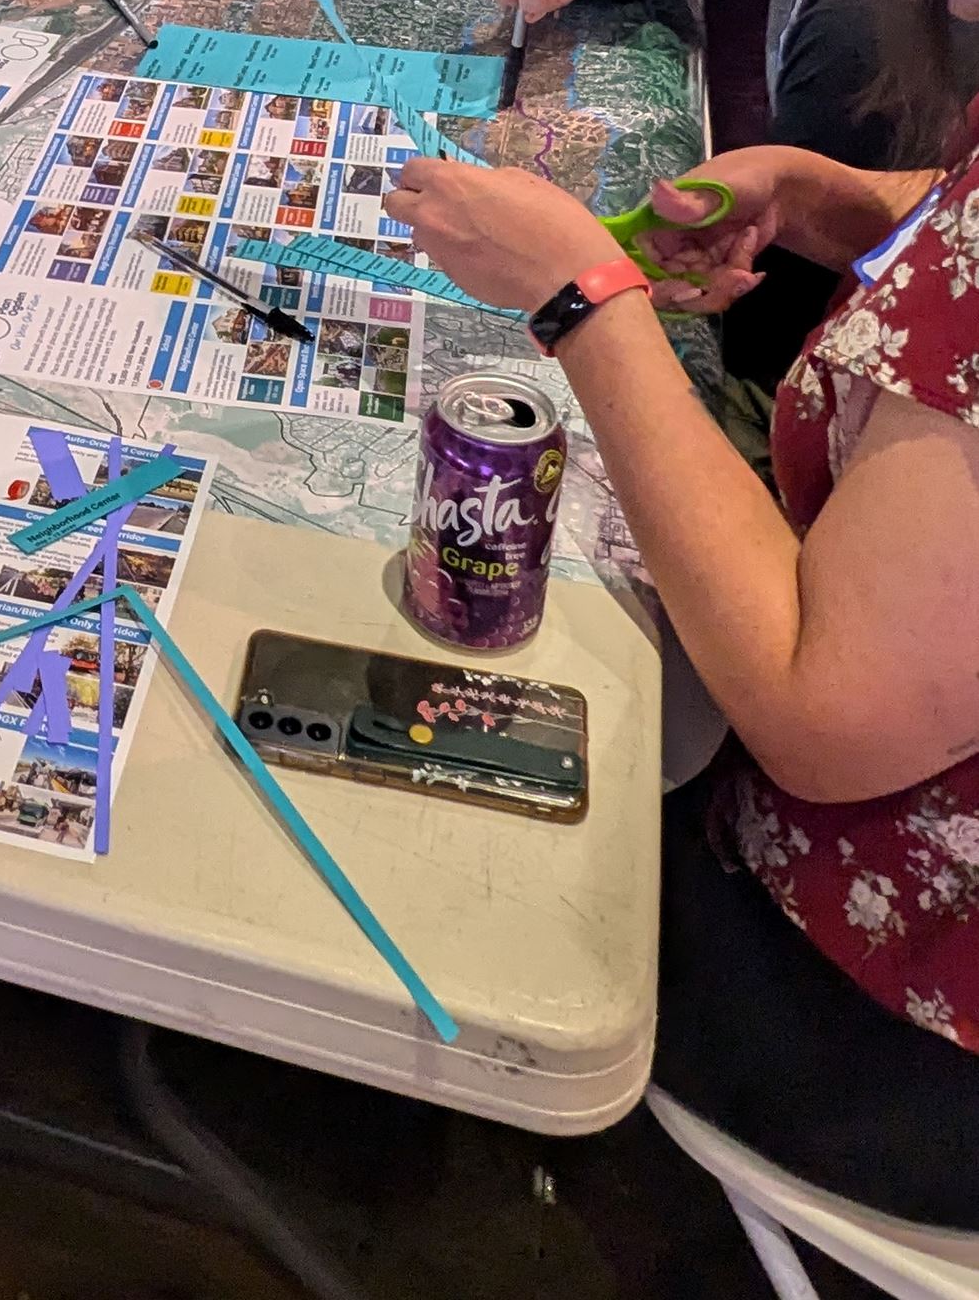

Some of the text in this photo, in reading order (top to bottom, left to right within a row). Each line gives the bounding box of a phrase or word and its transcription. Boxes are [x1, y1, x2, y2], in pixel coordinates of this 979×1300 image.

[5, 290, 31, 317] Ogden
[64, 433, 160, 459] Auto-Oried Corrid
[27, 506, 92, 543] Neighborhood
[90, 492, 121, 510] Center
[117, 530, 147, 544] rridor
[441, 546, 519, 582] Grape
[70, 617, 94, 632] Only
